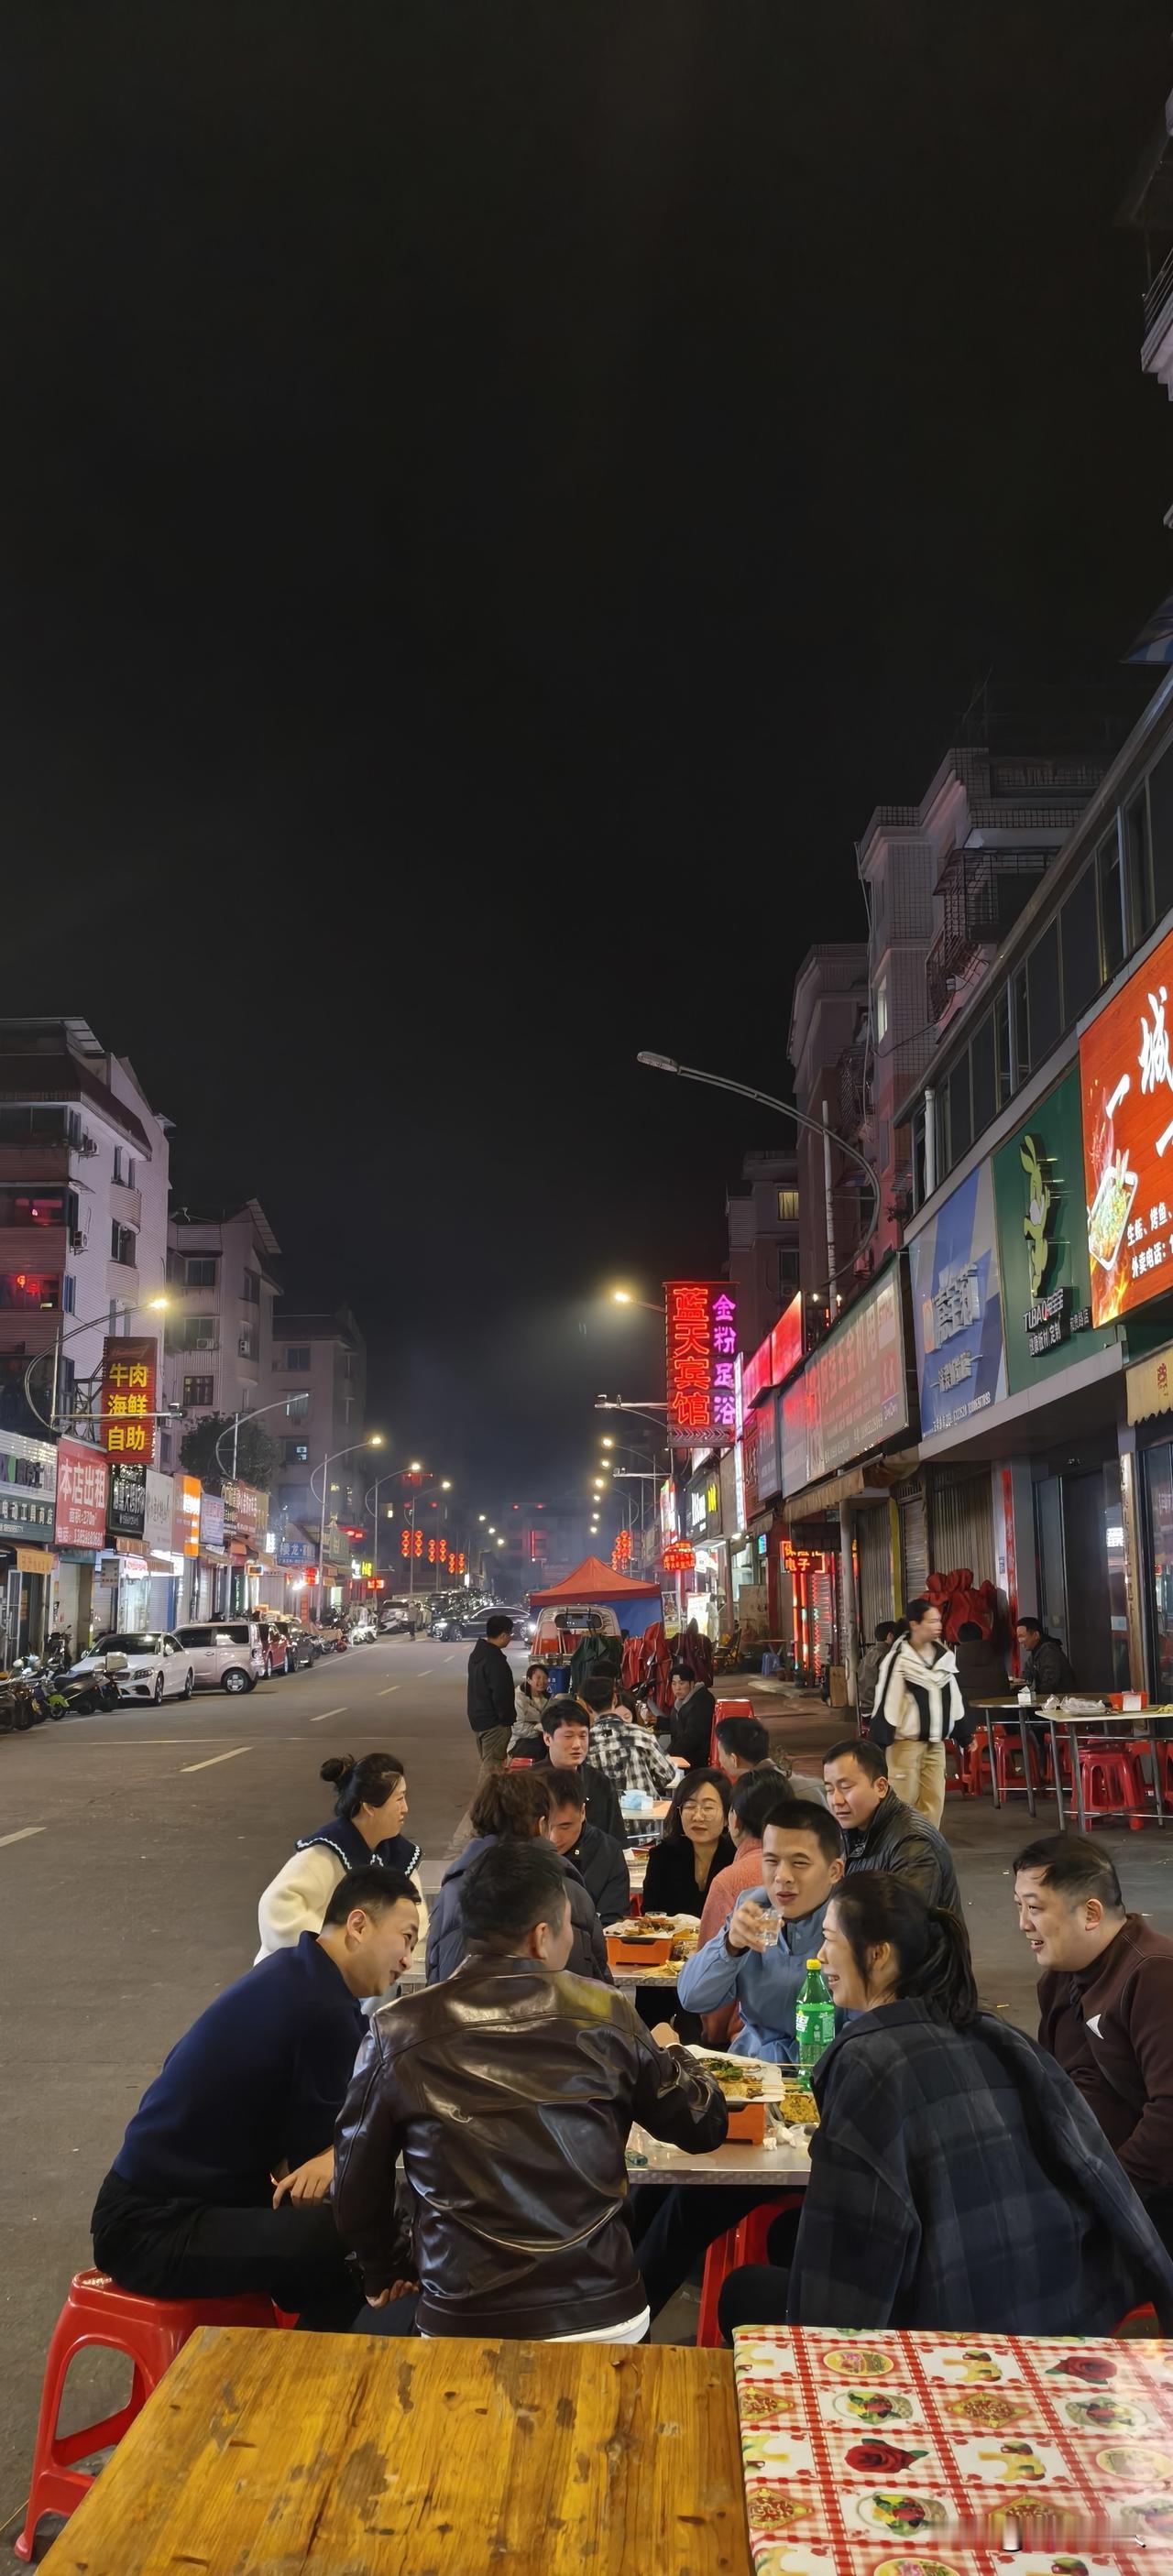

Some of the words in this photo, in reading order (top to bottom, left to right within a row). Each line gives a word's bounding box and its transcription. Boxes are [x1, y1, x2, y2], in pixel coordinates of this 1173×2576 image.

[672, 1287, 711, 1426] 蓝天宾馆
[712, 1293, 736, 1426] 金粉足浴
[109, 1362, 148, 1388] 牛肉
[107, 1393, 148, 1419] 海鲜
[107, 1425, 146, 1451] 自助
[60, 1457, 105, 1509] 本店出租
[784, 1557, 811, 1572] 电子
